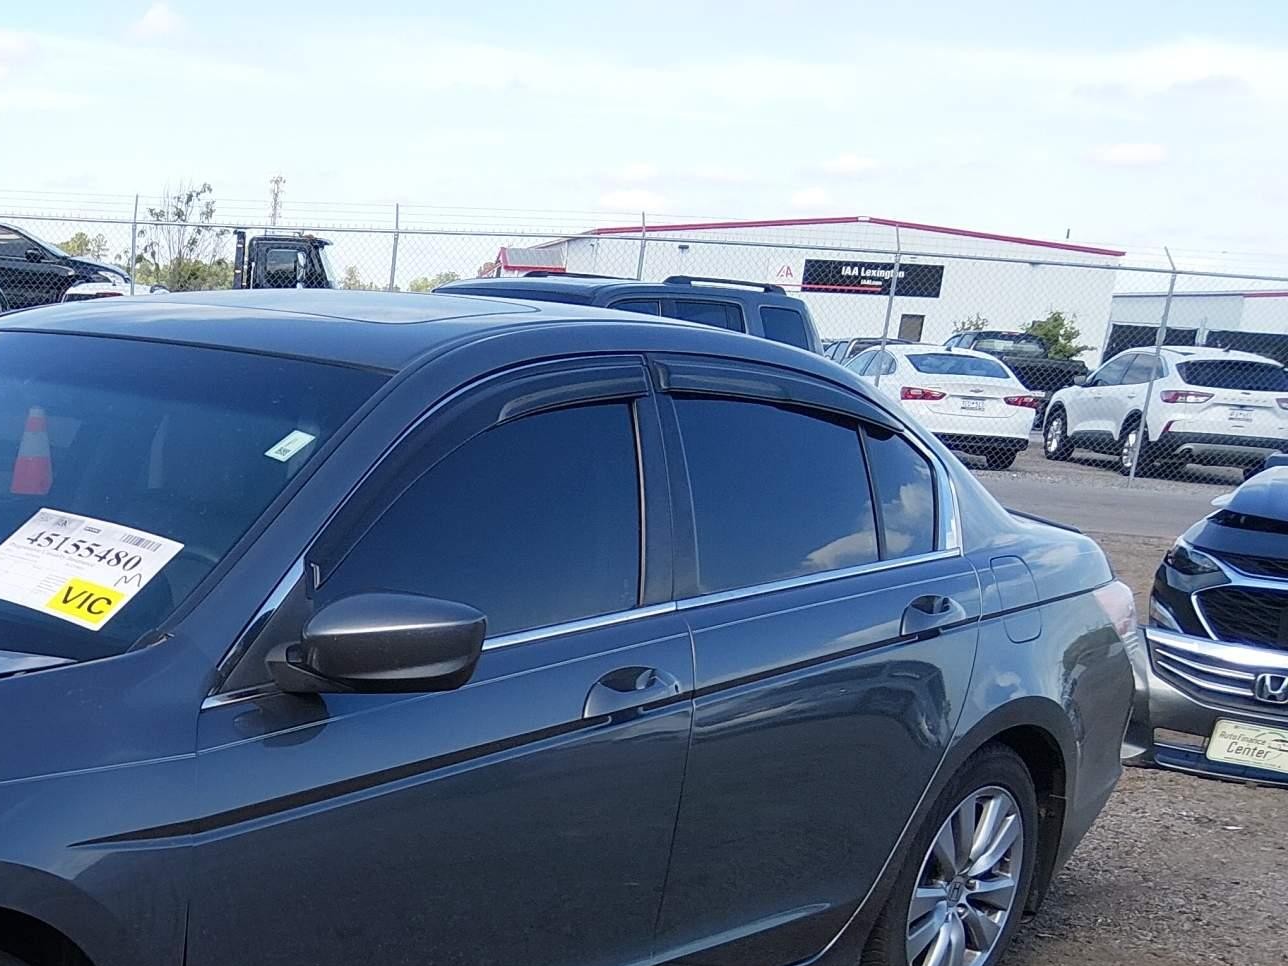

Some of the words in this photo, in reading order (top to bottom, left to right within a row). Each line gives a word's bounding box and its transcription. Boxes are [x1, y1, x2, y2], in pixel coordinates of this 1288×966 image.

[841, 266, 859, 276] IAA
[861, 267, 905, 279] Lexingtn
[26, 530, 143, 572] 45155480
[62, 586, 112, 616] VIC
[1227, 741, 1272, 759] Center
